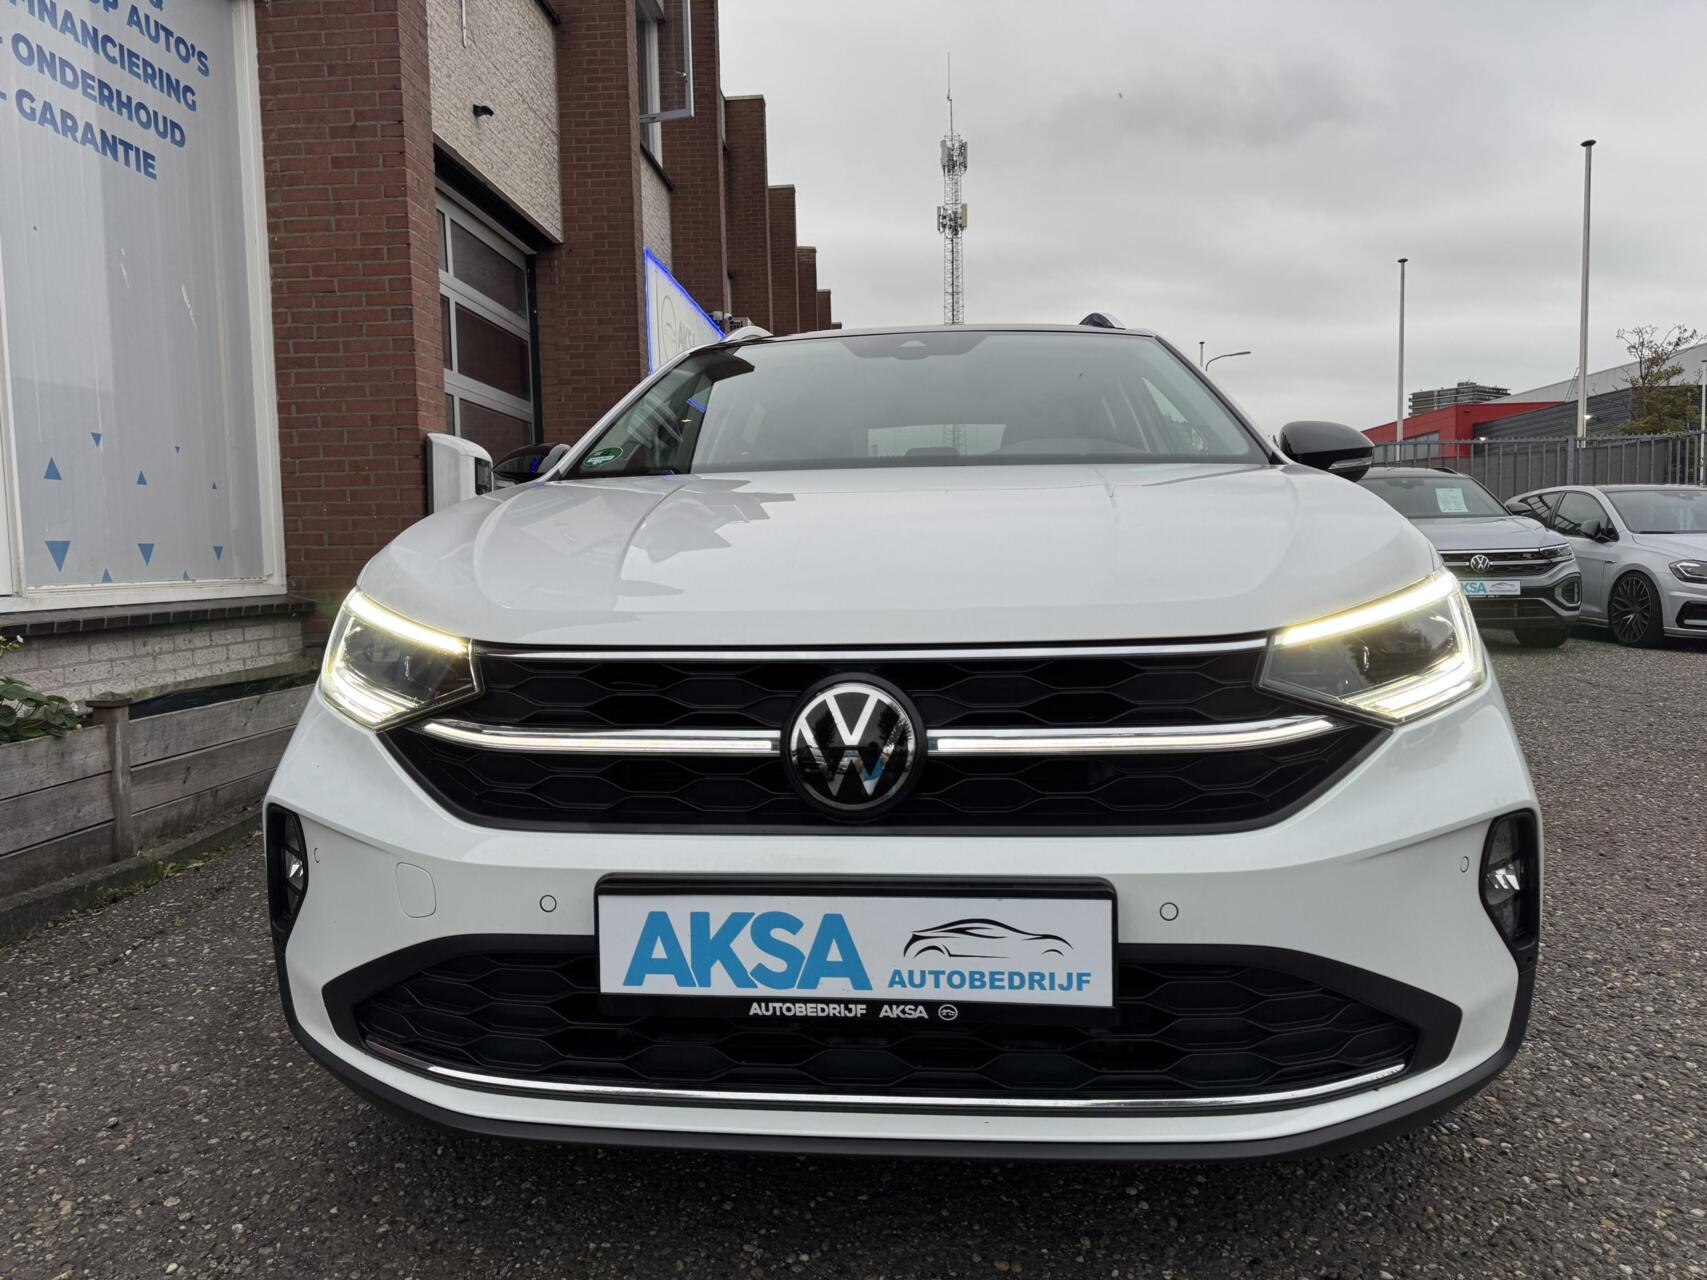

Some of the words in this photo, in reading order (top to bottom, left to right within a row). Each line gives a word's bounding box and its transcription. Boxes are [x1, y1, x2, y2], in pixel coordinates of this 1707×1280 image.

[9, 0, 197, 112] INANCIERING
[126, 4, 210, 77] AUTO'S
[11, 32, 186, 148] ONDERHOUD
[15, 88, 157, 180] GARANTIE
[1460, 582, 1487, 593] KSA
[622, 910, 872, 991] AKSA
[888, 969, 1091, 992] AUTOBEDRIJF
[749, 1002, 867, 1017] AUTOBEDRIJF
[879, 1004, 928, 1019] AKSA
